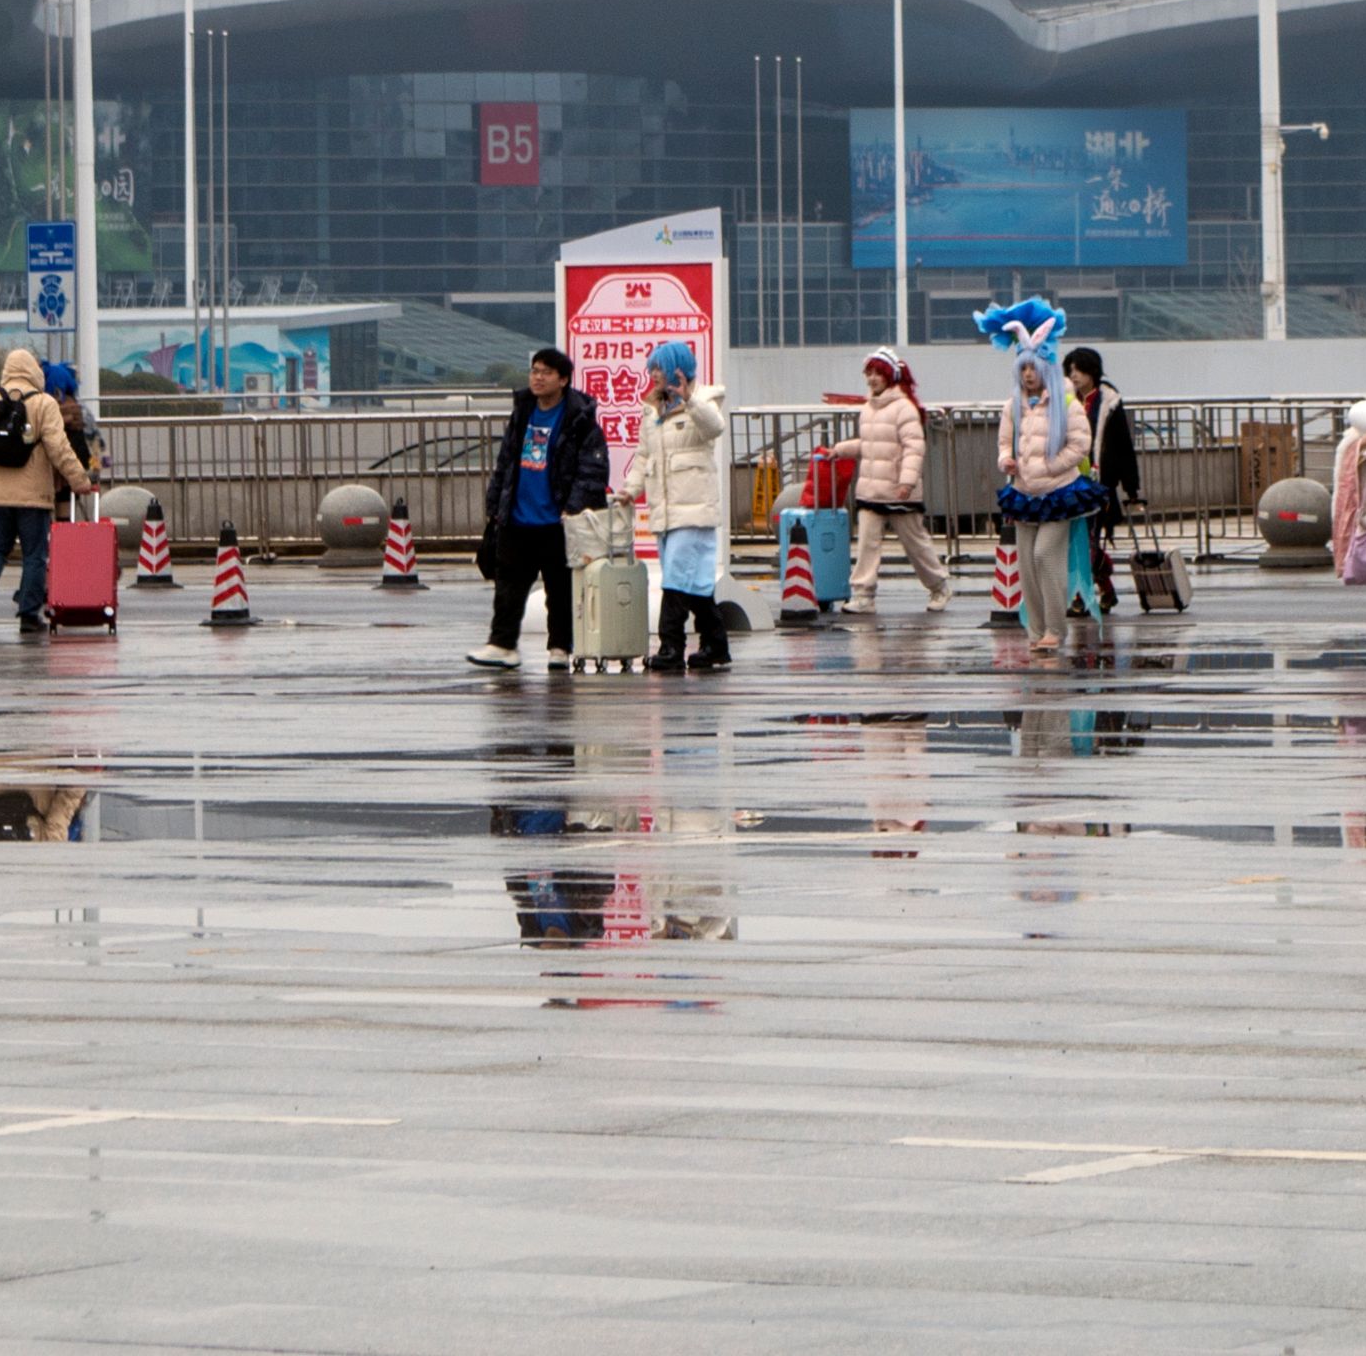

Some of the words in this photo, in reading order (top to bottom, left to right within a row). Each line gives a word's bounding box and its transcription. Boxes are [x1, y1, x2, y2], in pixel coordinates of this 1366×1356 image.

[488, 125, 533, 164] B5
[1084, 130, 1151, 160] 湖北
[583, 341, 696, 360] 2月7日-2
